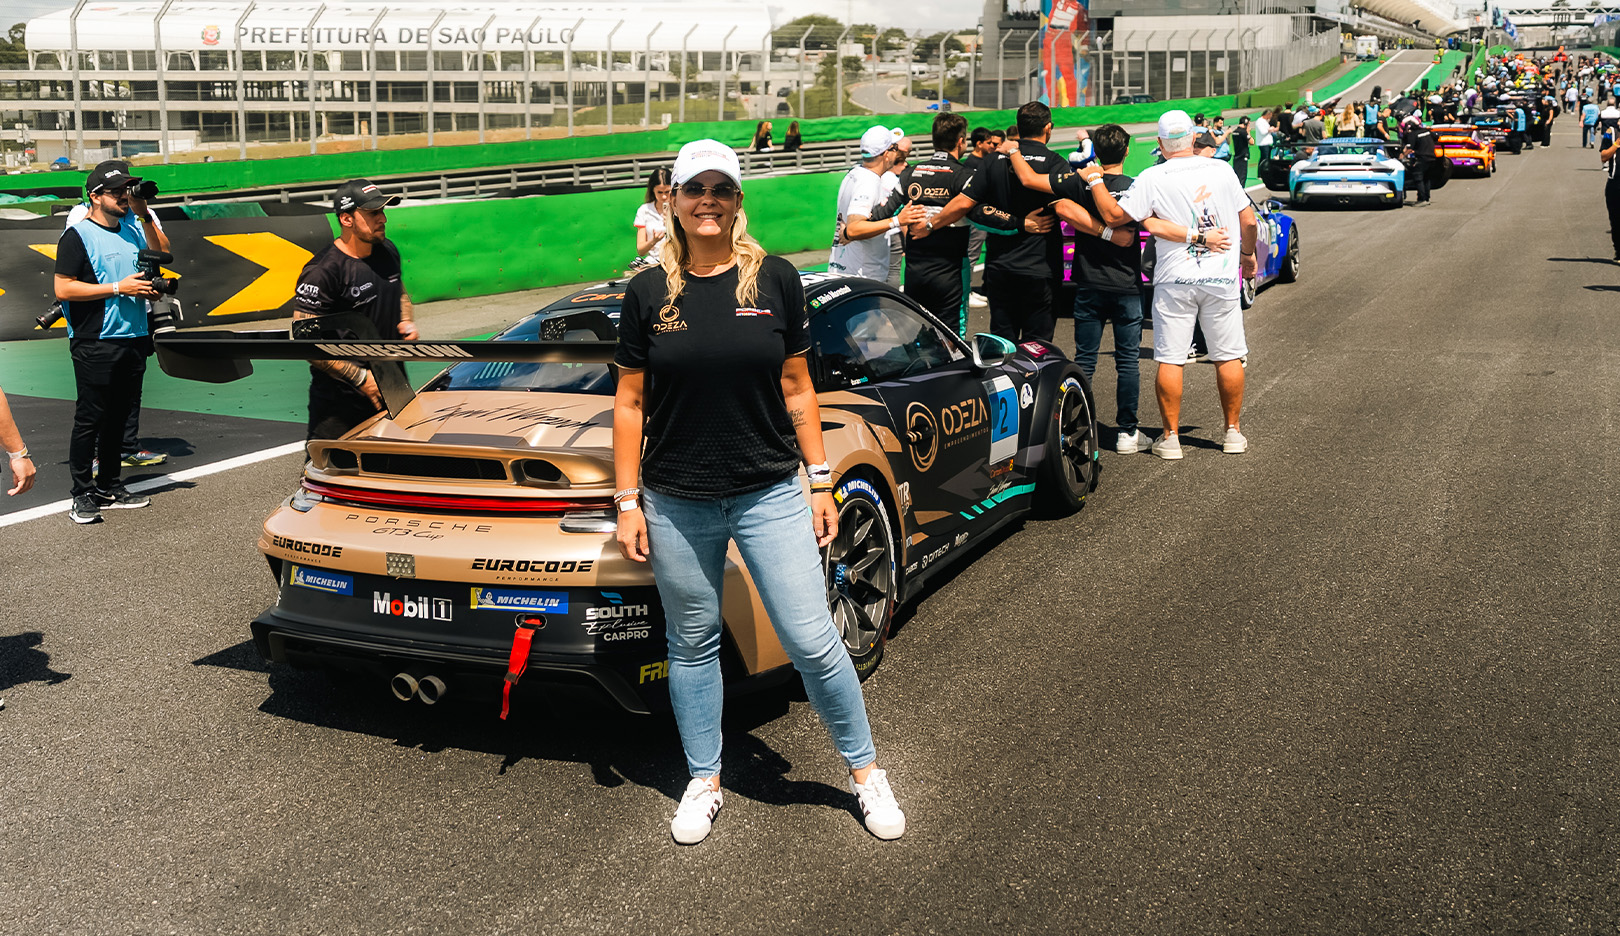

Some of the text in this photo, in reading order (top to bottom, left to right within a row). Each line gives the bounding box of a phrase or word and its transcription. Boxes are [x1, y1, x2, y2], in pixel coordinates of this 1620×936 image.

[237, 26, 387, 43] PREFEITURA
[398, 27, 430, 43] DE
[496, 28, 575, 44] PAULO
[924, 187, 950, 196] ODEZA
[652, 320, 688, 332] ODEZA
[941, 397, 988, 435] ODEZA
[999, 396, 1008, 435] 2
[847, 480, 880, 502] MICHELIN
[896, 481, 910, 505] TR
[345, 514, 493, 533] PORSCHE
[372, 527, 445, 541] GT3 Cup
[273, 535, 343, 558] EUROCODE
[471, 558, 595, 573] EUROCODE
[305, 575, 348, 589] MICHELIN
[373, 591, 429, 619] Mobil
[496, 596, 560, 607] MICHELIN
[585, 604, 648, 620] SOUTH
[603, 630, 649, 641] CARPRO
